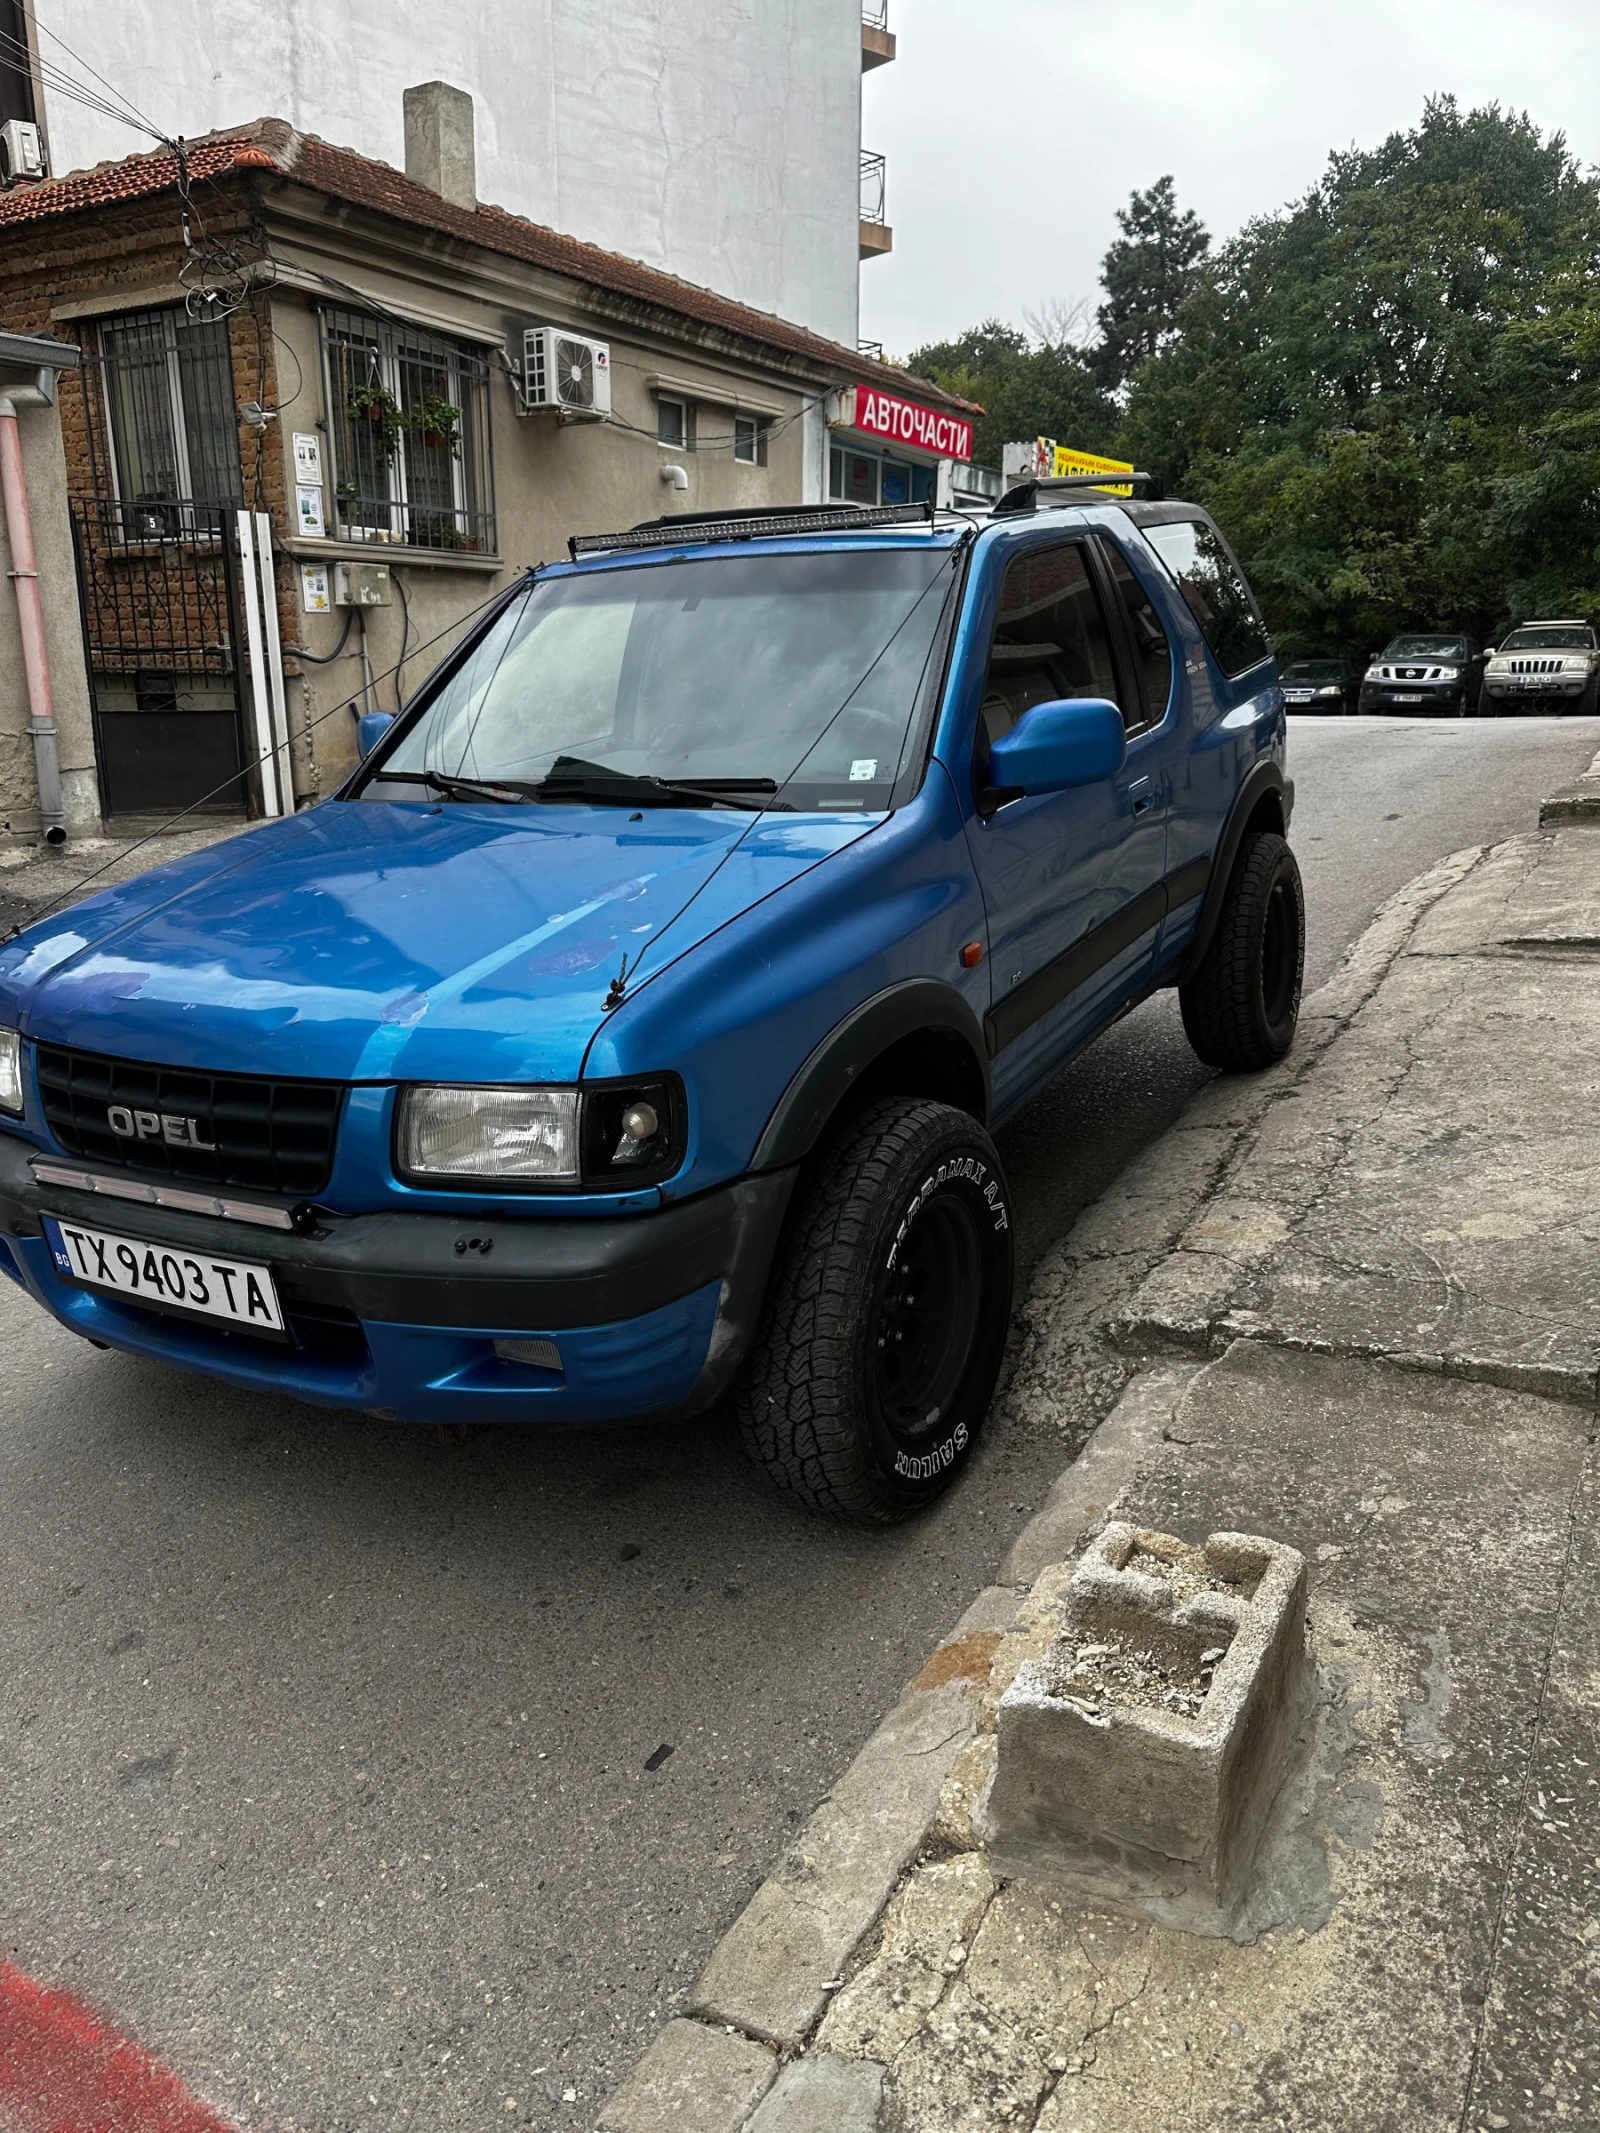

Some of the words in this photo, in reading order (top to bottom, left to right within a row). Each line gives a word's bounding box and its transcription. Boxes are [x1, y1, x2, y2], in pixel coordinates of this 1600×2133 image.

[862, 393, 968, 457] АВТОЧАСТИ
[149, 517, 156, 529] 5
[108, 1106, 217, 1150] OPEL
[983, 1179, 1008, 1231] A/T
[55, 1251, 70, 1268] BG
[116, 1242, 210, 1306] 9403
[894, 1422, 969, 1479] SAILUN
